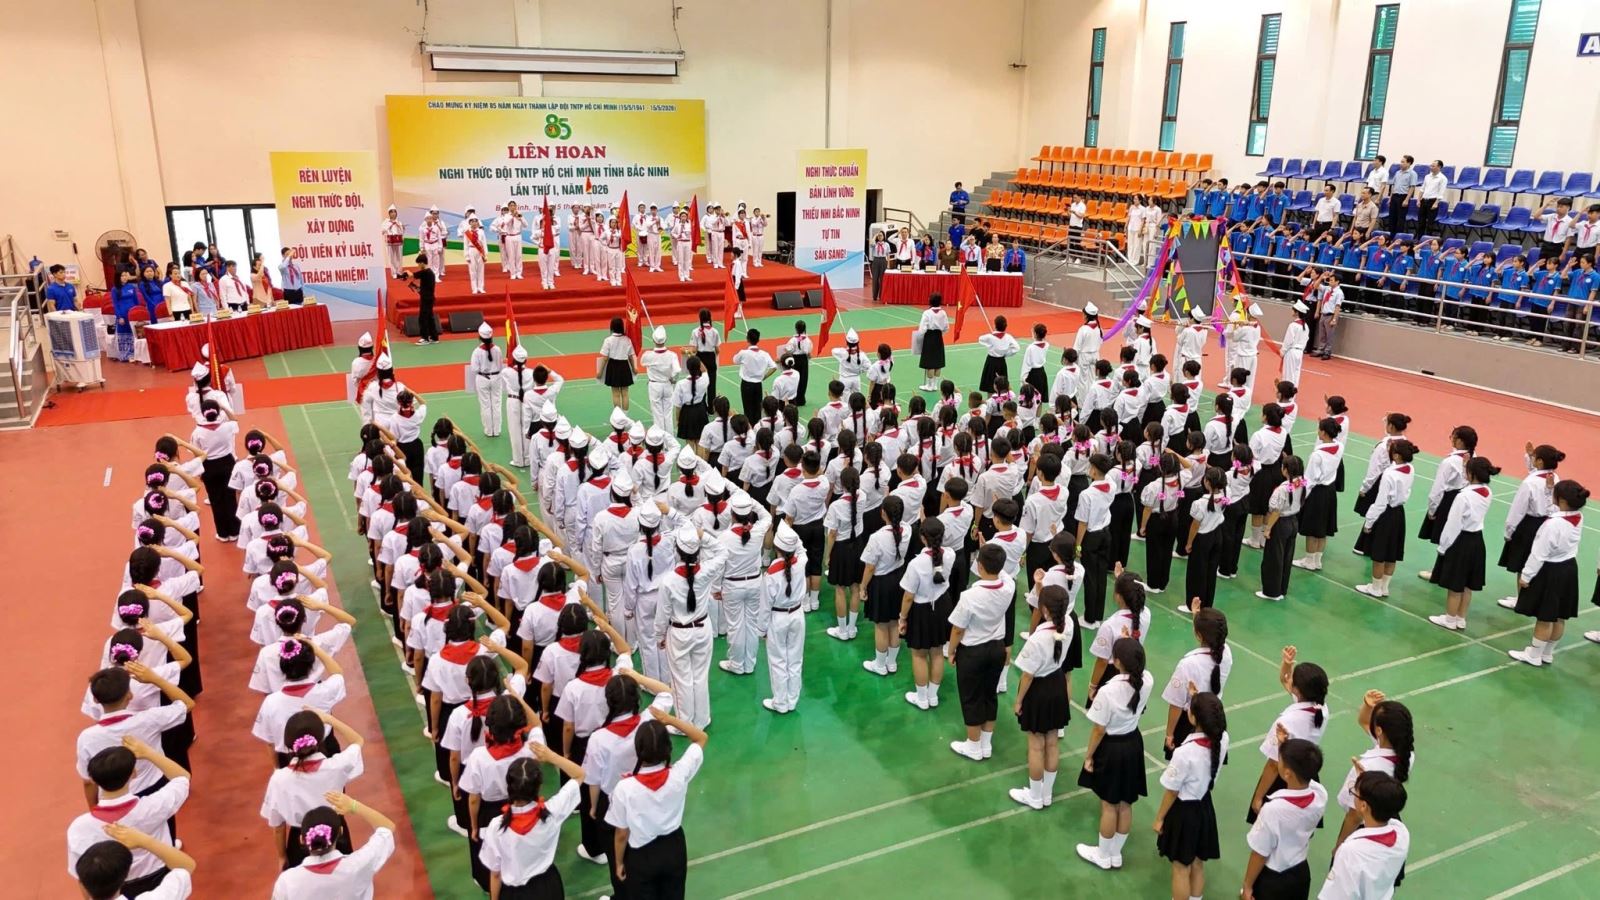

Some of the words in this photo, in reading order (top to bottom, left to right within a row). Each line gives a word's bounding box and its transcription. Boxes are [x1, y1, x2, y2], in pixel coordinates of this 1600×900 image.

[1582, 36, 1600, 54] A
[544, 114, 572, 140] 85
[508, 142, 550, 159] LIÊN
[556, 146, 606, 159] HOAN
[322, 166, 352, 184] LUYỆN
[439, 168, 464, 180] NGHI
[466, 166, 493, 178] THỨC
[496, 166, 512, 180] ĐỘI
[514, 168, 540, 178] TNTP
[576, 168, 601, 178] MINH
[648, 166, 670, 176] NINH
[806, 166, 821, 178] NGHI
[292, 195, 316, 208] NGHI
[318, 193, 343, 208] THỨC
[345, 192, 364, 210] ĐỘI,
[821, 209, 832, 219] NHI
[846, 208, 860, 218] NINH
[306, 218, 326, 234] XÂY
[328, 220, 354, 236] DỰNG
[831, 229, 840, 239] TIN
[310, 243, 334, 258] VIÊN
[350, 242, 374, 260] LUẬT,
[335, 266, 370, 284] NHIỆM!
